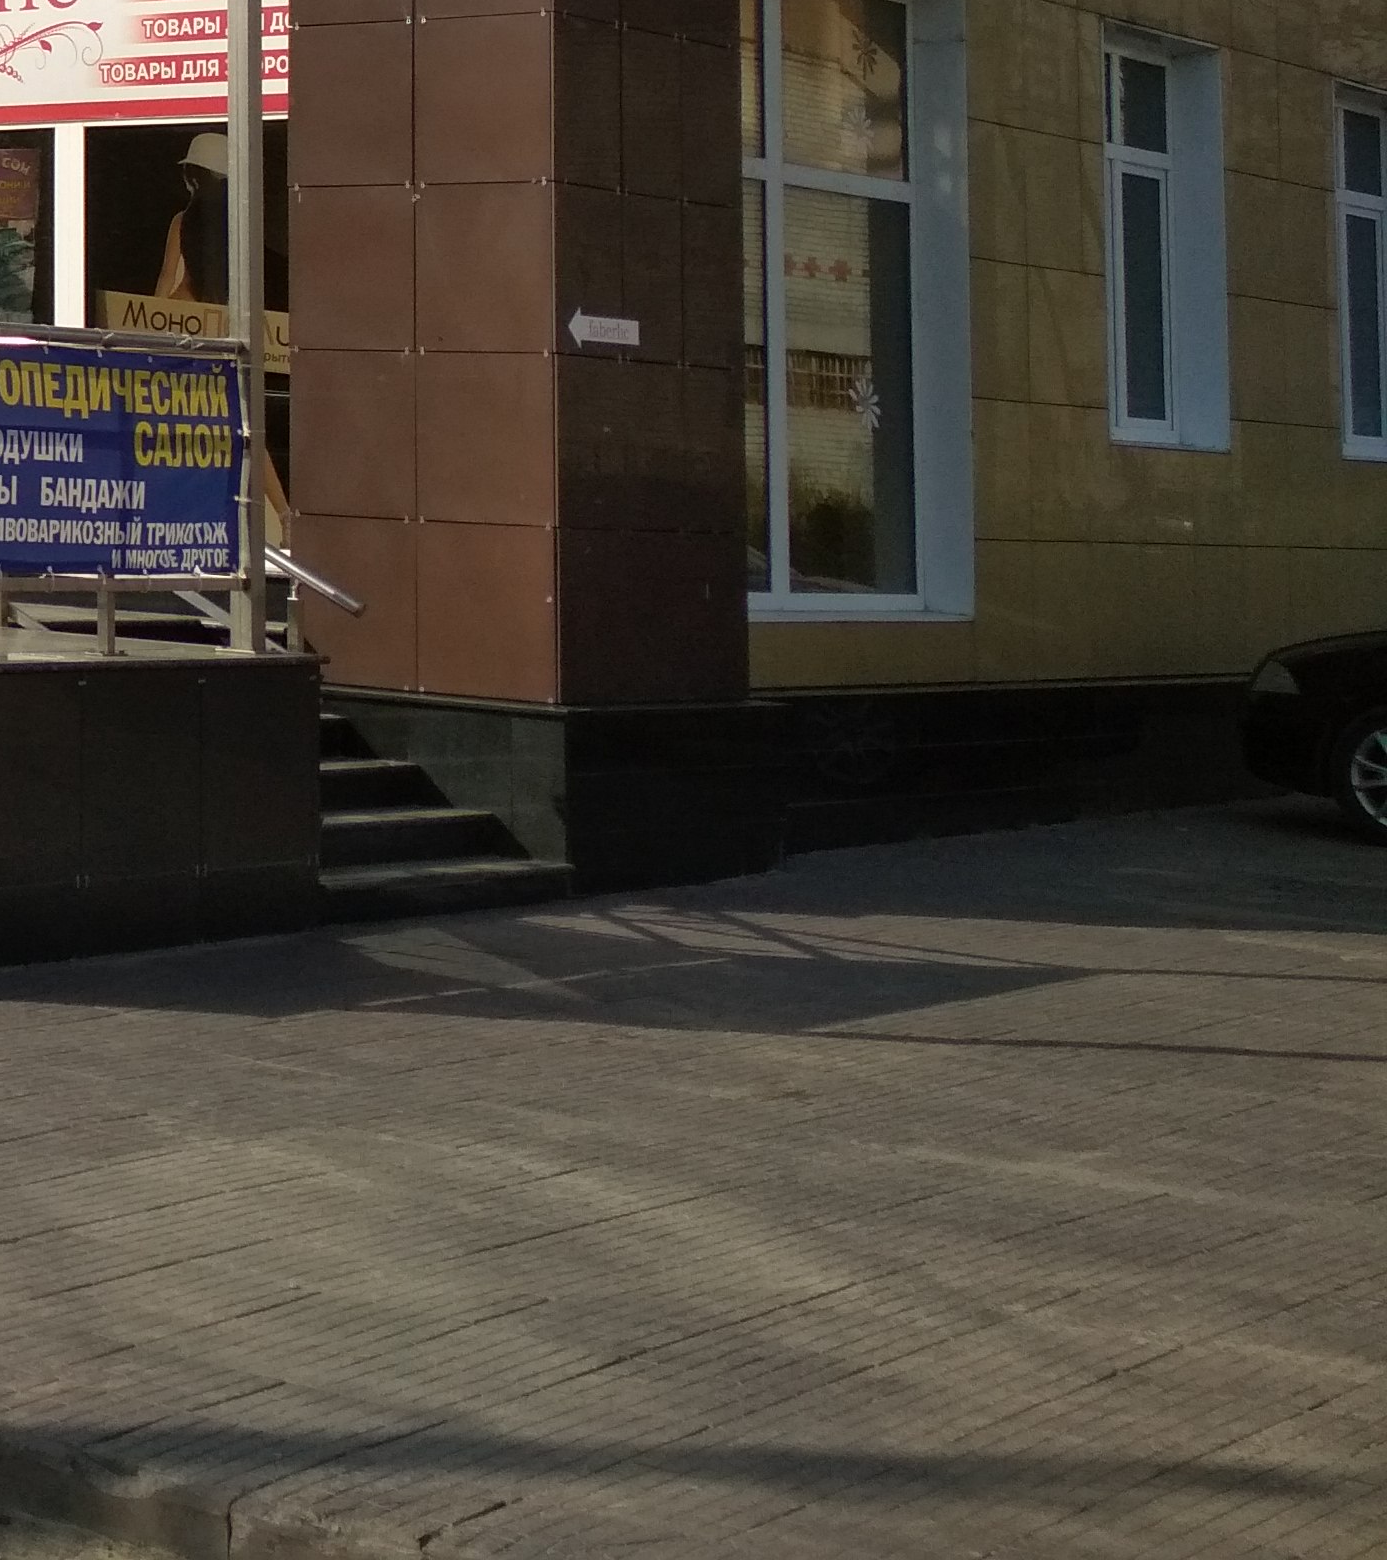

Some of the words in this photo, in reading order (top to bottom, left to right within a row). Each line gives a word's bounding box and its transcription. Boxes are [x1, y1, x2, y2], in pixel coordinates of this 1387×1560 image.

[143, 17, 221, 38] ТОВАРЫ
[100, 62, 176, 83] ТОВАРЫ
[181, 59, 219, 80] ДЛЯ
[134, 421, 232, 468] САЛОН
[40, 476, 146, 514] БАНДАЖИ
[112, 549, 121, 568] И
[125, 549, 177, 569] МНОГОЕ
[181, 549, 229, 571] ДРУГОЕ
